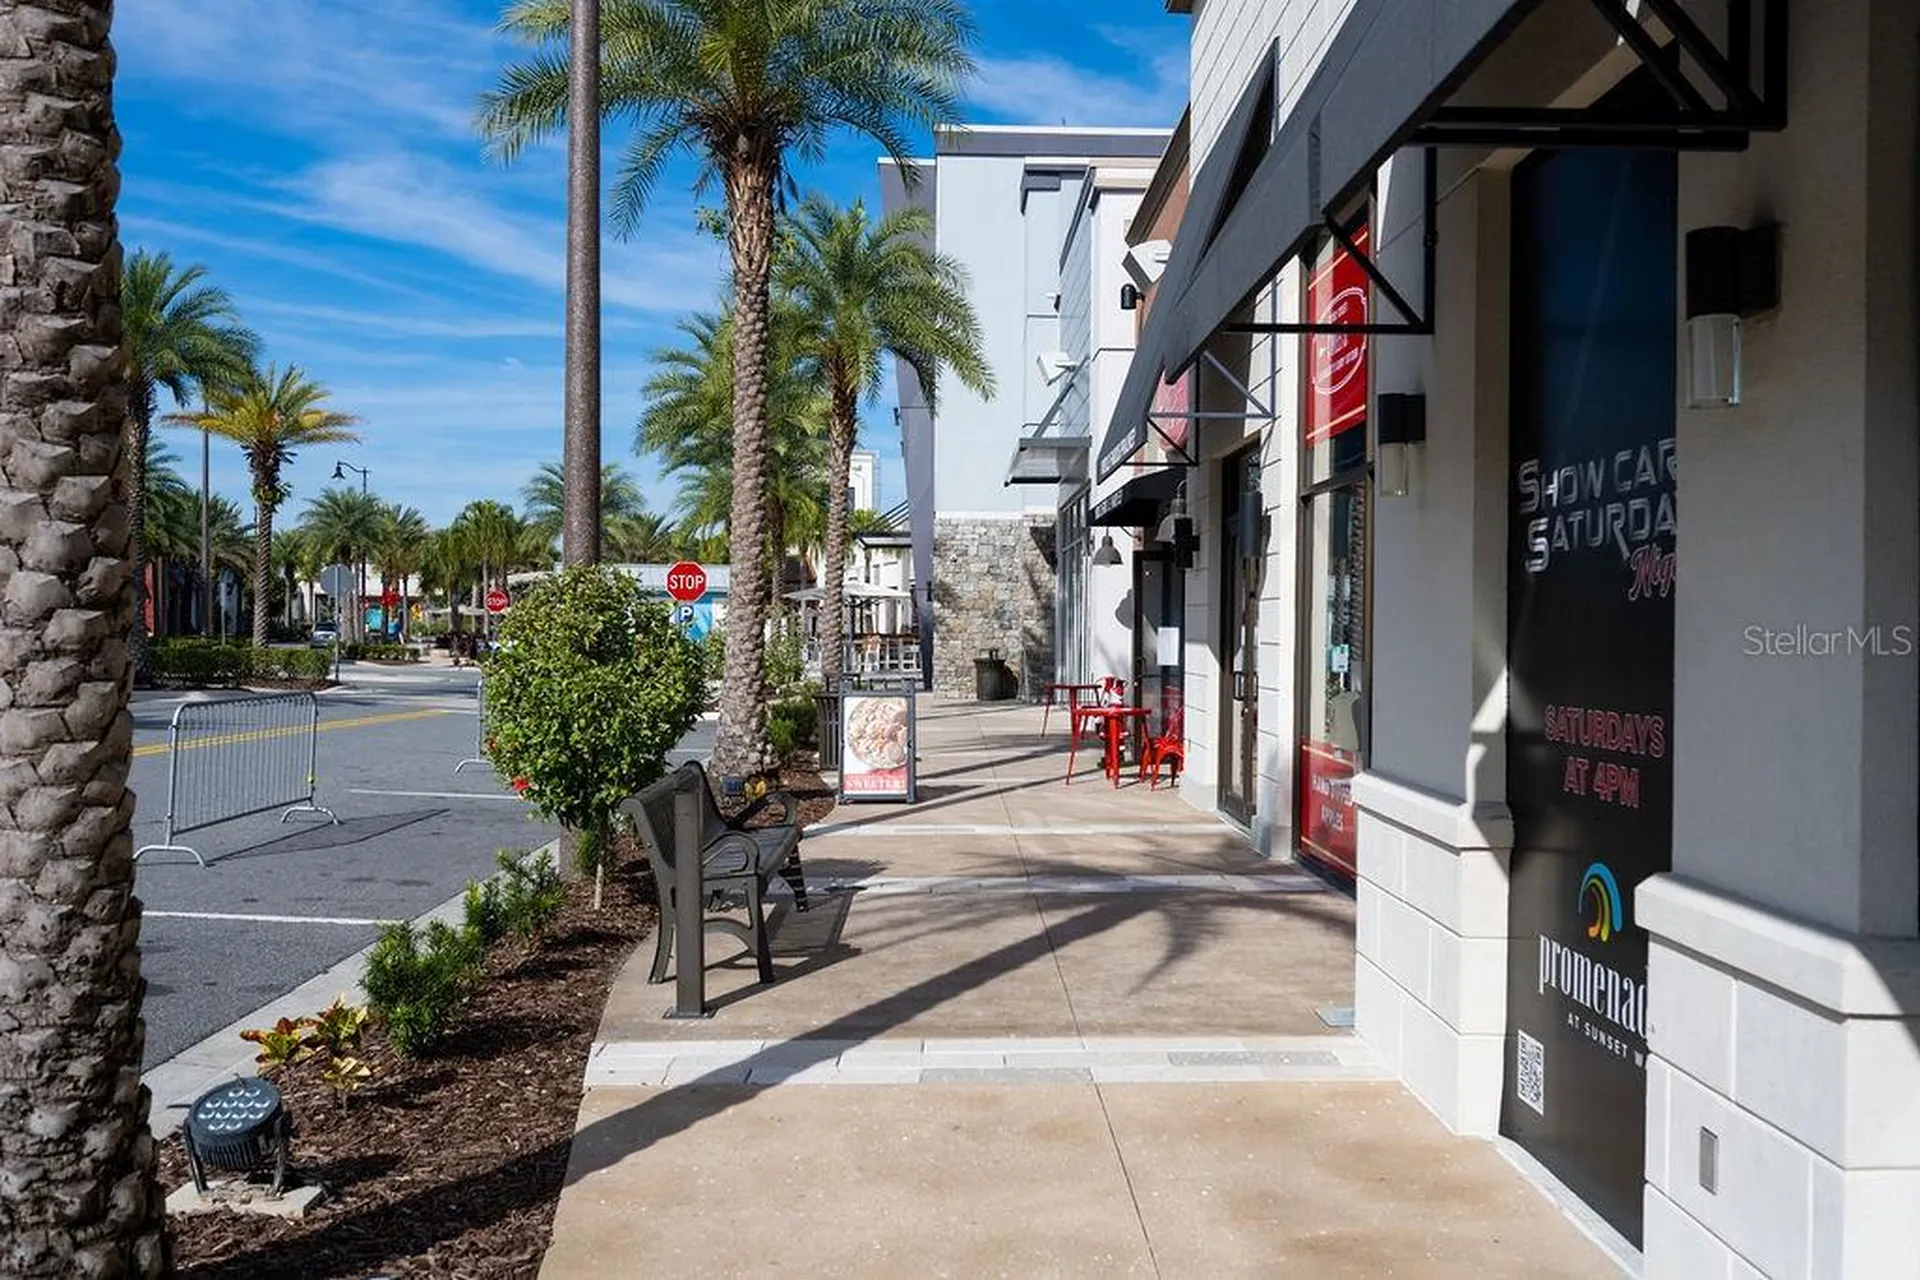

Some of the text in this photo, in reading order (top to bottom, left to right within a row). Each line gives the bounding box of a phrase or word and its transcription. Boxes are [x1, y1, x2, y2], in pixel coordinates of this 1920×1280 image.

[1518, 457, 1605, 514] SHOW
[487, 597, 508, 606] STOP
[669, 574, 704, 590] STOP
[1545, 704, 1666, 758] SATURDAYS
[1563, 756, 1639, 809] AT 4PM
[1567, 1012, 1580, 1029] AT
[1584, 1021, 1628, 1058] SUNSET
